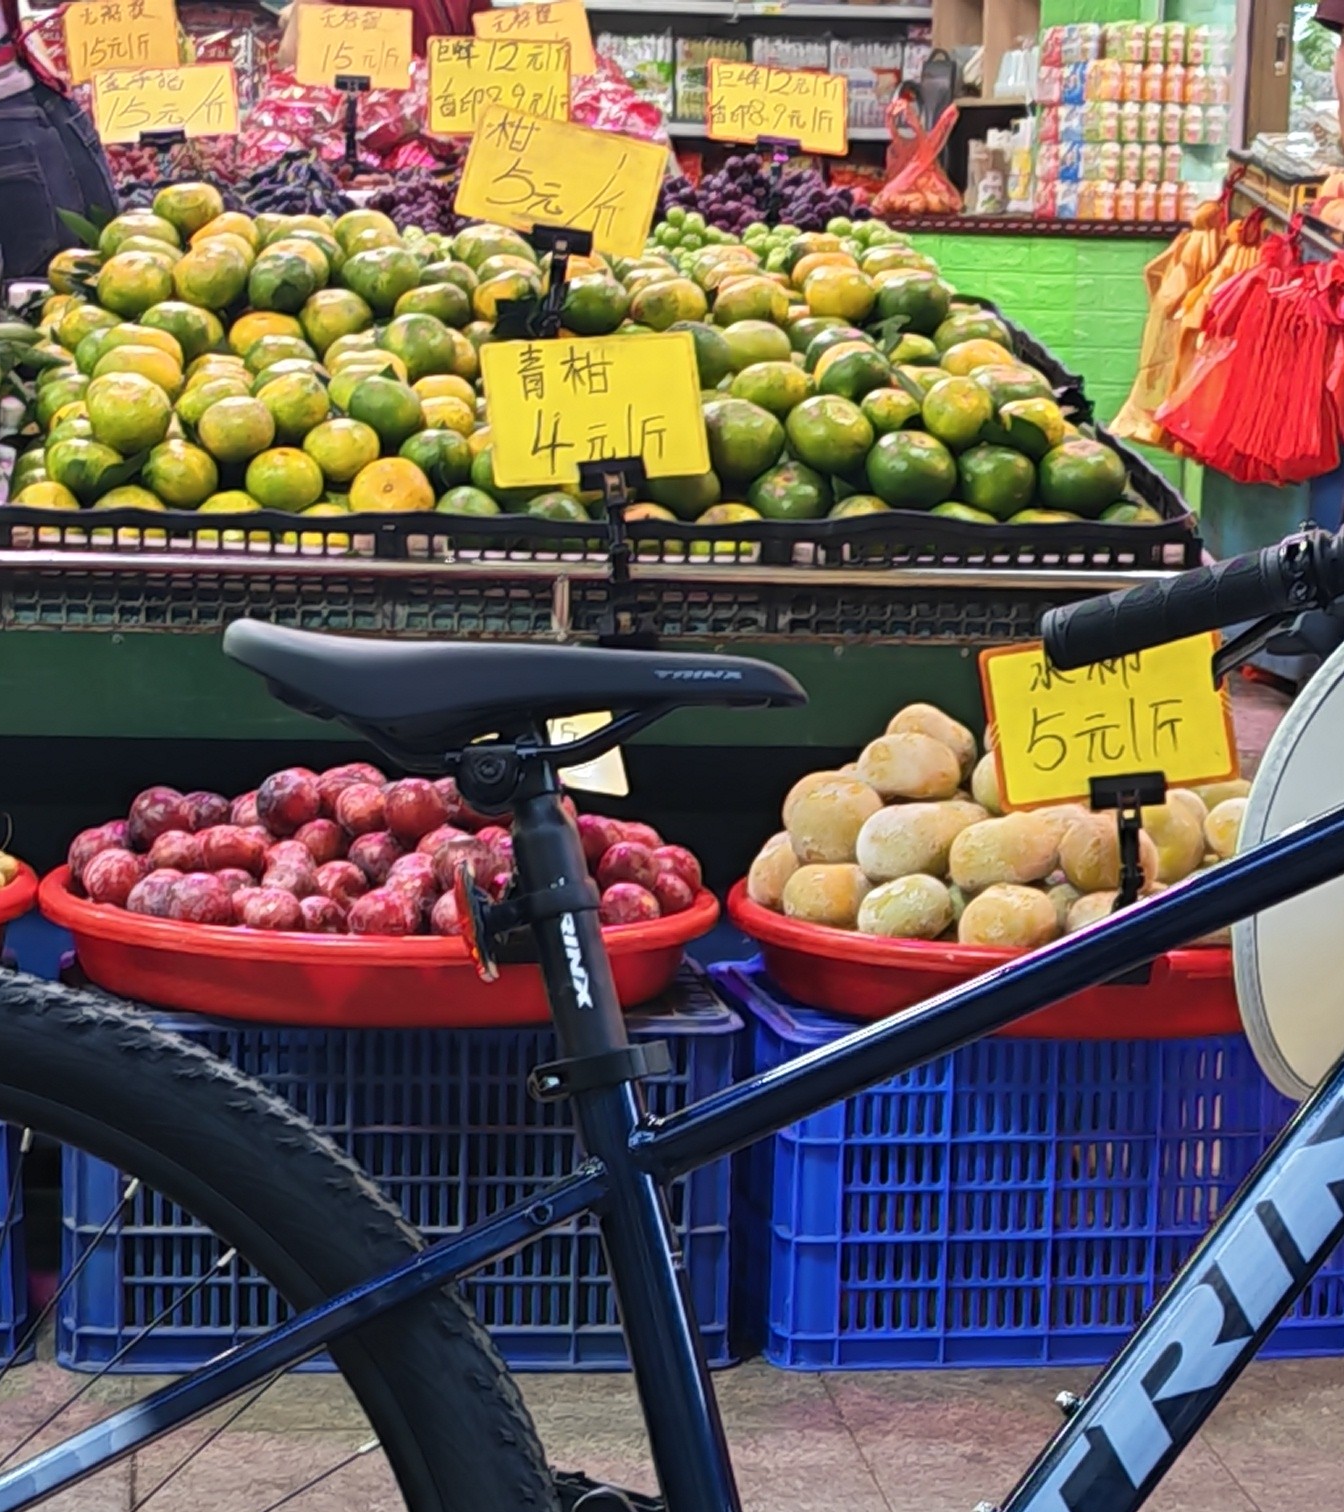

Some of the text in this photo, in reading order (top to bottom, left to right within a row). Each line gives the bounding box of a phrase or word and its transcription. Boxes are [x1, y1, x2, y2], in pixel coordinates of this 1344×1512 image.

[105, 75, 227, 133] 15元/斤
[485, 153, 625, 239] 5元/斤
[516, 343, 613, 401] 青柑
[654, 669, 743, 680] TRINX
[559, 912, 594, 1009] RINX
